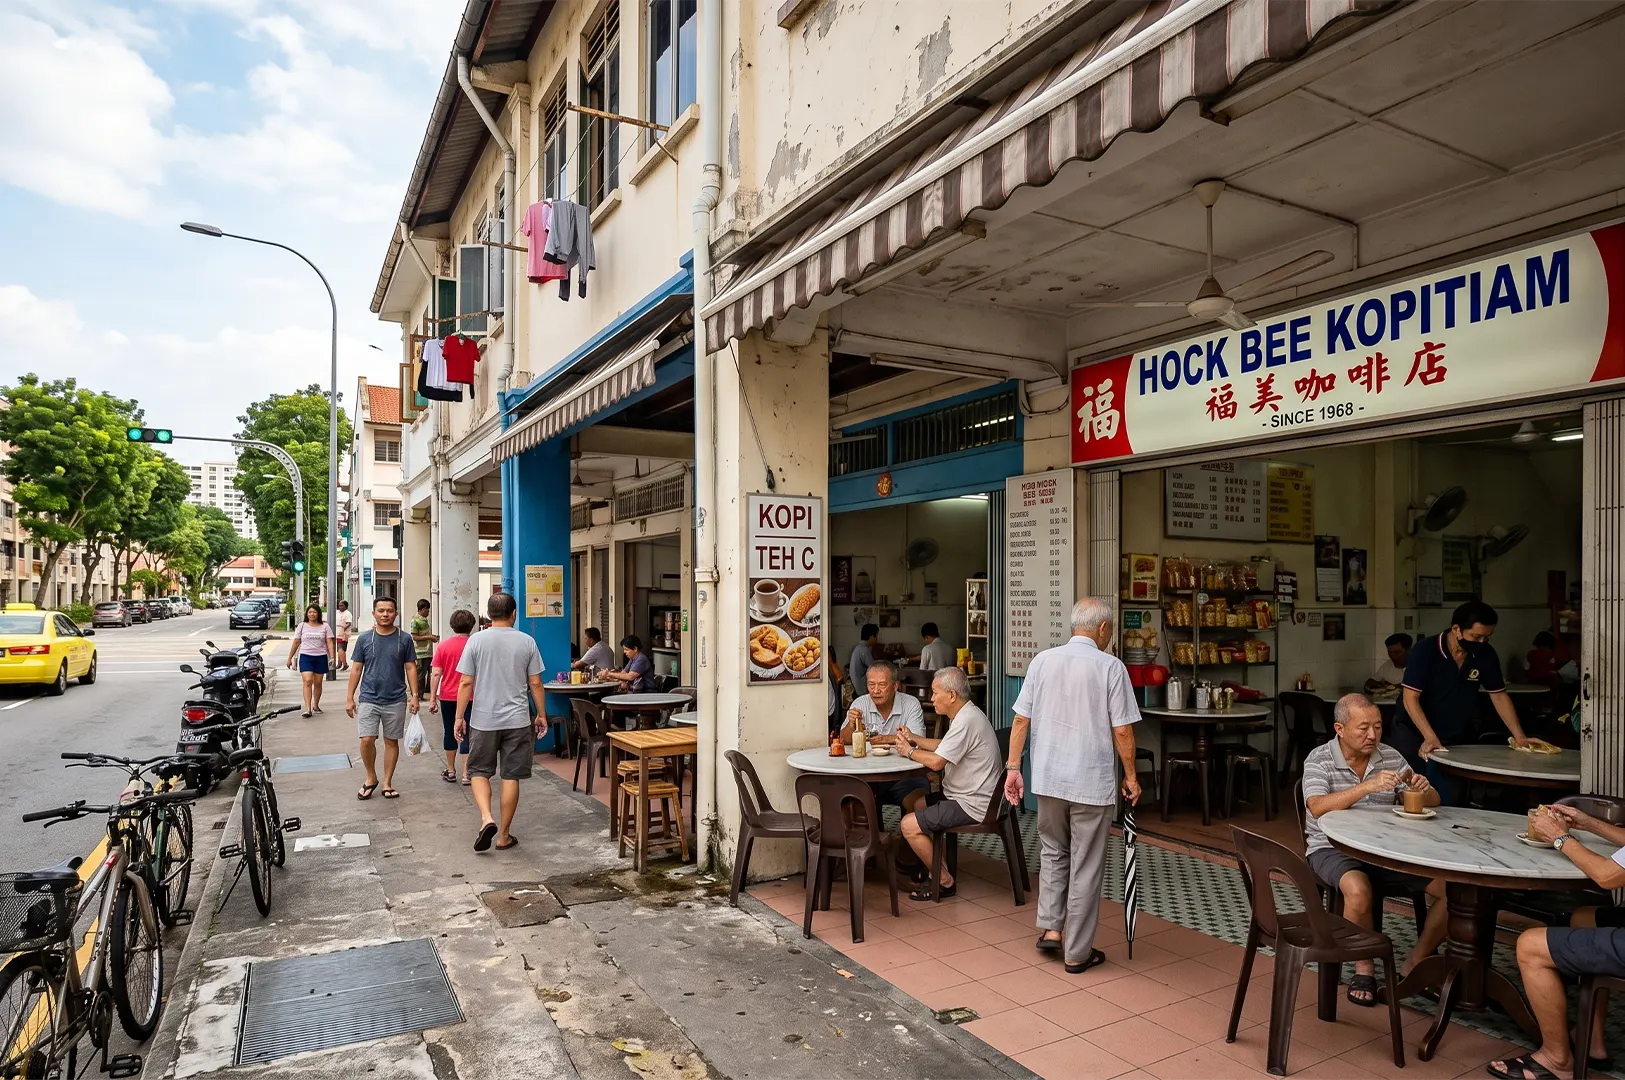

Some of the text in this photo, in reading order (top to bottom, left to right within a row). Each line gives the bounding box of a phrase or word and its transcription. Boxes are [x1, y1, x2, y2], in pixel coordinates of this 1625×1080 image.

[1139, 250, 1570, 396] HOCK BEE KOPITIAM
[1205, 341, 1448, 422] 福美咖啡店
[1075, 377, 1121, 444] 福
[1270, 408, 1315, 428] SINCE
[1319, 402, 1354, 420] 1968
[759, 503, 813, 530] KOPI
[755, 545, 815, 571] TEH C
